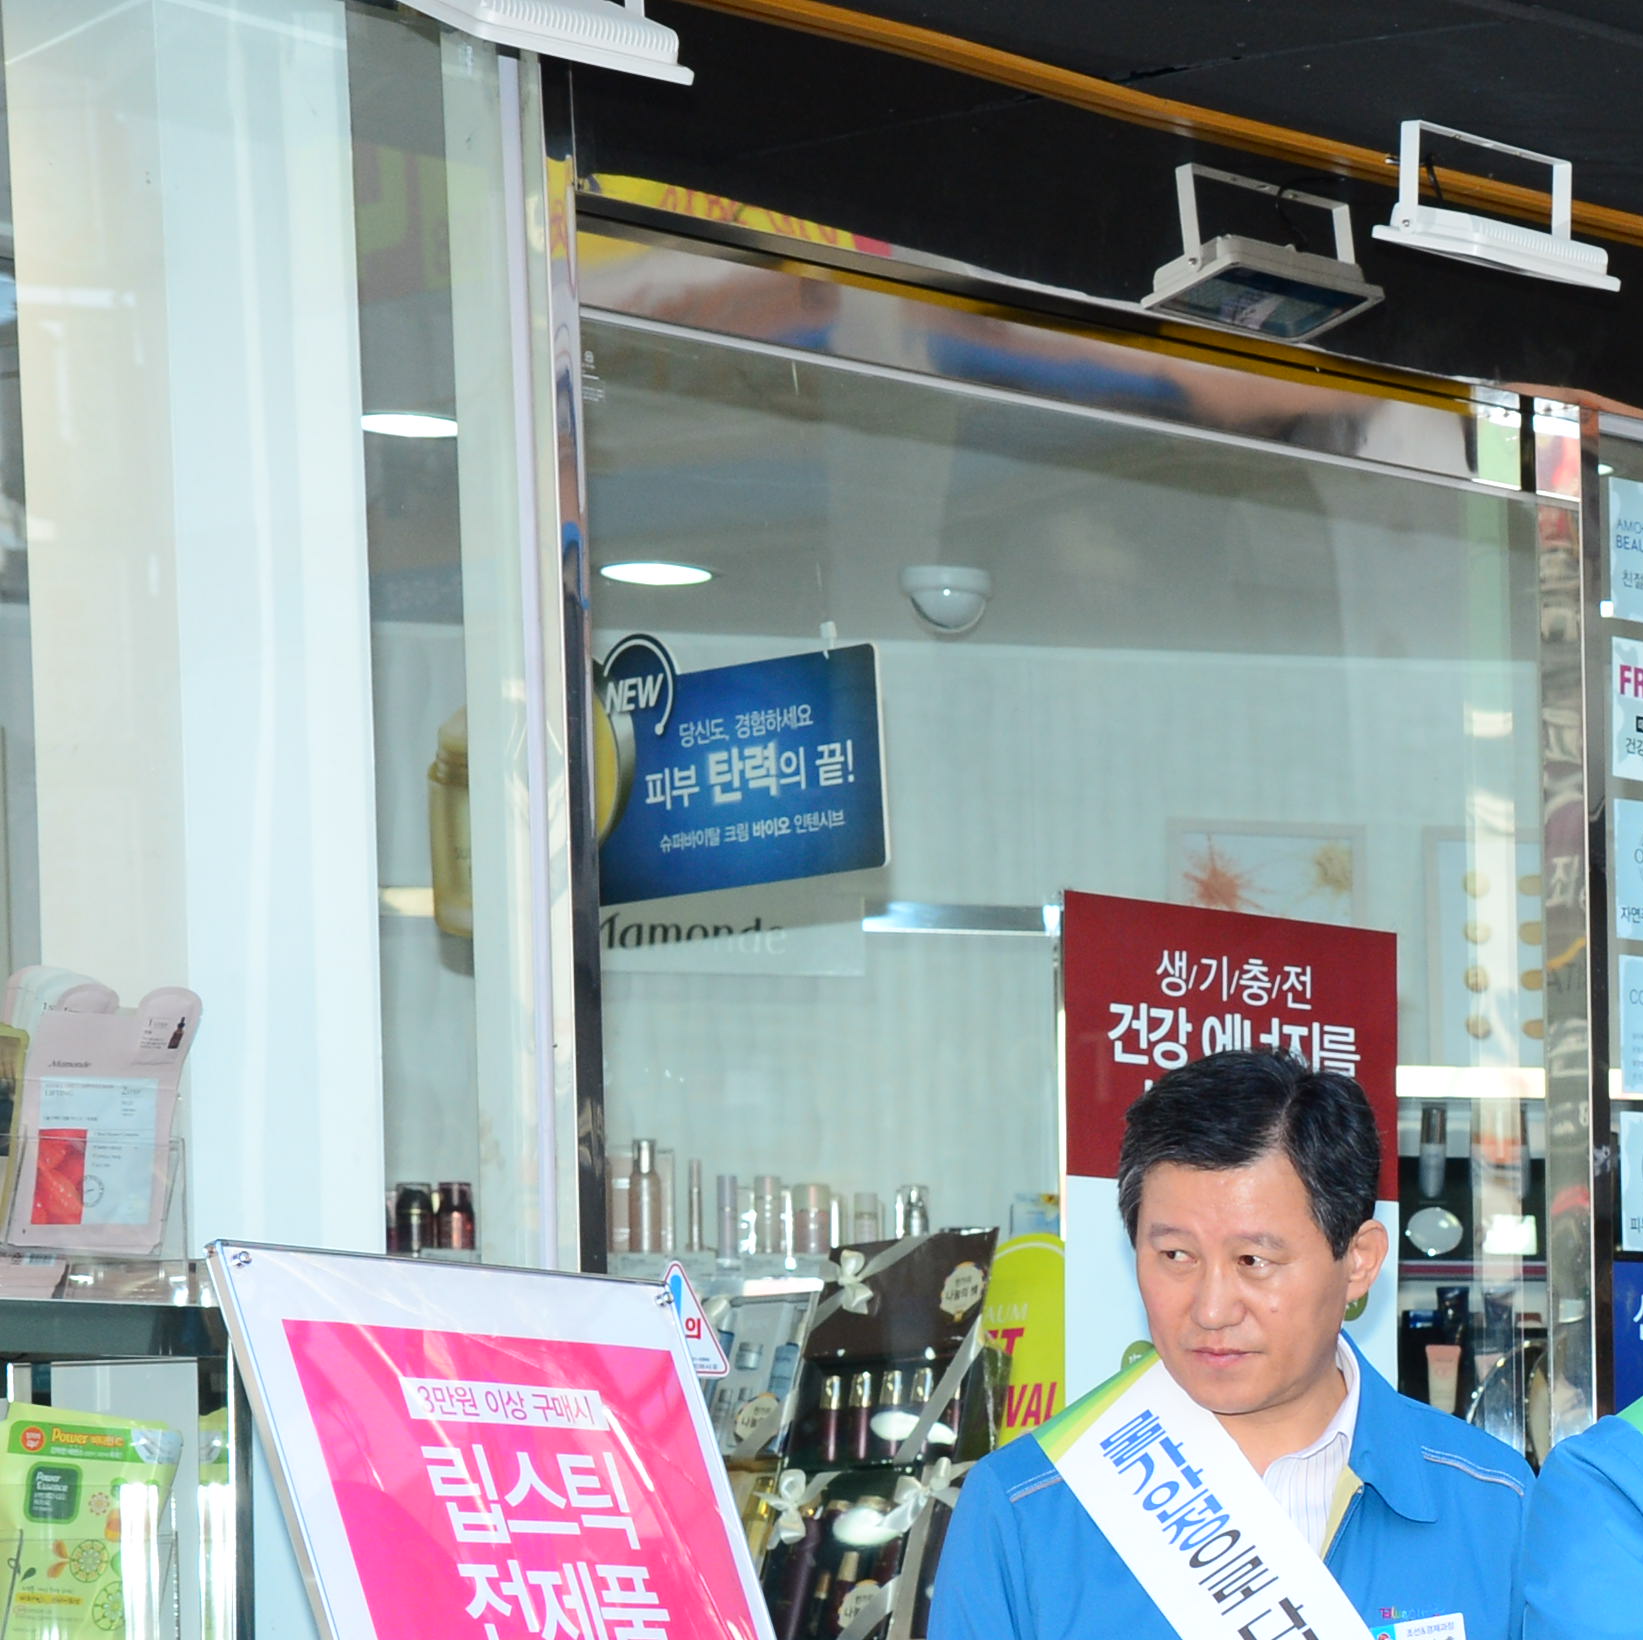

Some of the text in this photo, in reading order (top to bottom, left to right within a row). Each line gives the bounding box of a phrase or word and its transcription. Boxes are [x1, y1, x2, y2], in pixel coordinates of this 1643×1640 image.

[605, 673, 664, 714] NEW
[679, 704, 813, 748] 당신도, 경험하세요
[645, 740, 855, 810] 피부 탄력의 끝!
[659, 810, 845, 854] 슈퍼바이탈 크림 바이오 인텐시브
[1108, 1003, 1361, 1078] 건강 에너지를
[416, 1386, 595, 1426] 3만원 이상 구매시
[52, 1428, 87, 1445] Power
[422, 1444, 641, 1551] 립스틱
[1099, 1409, 1280, 1617] 물가안정으로
